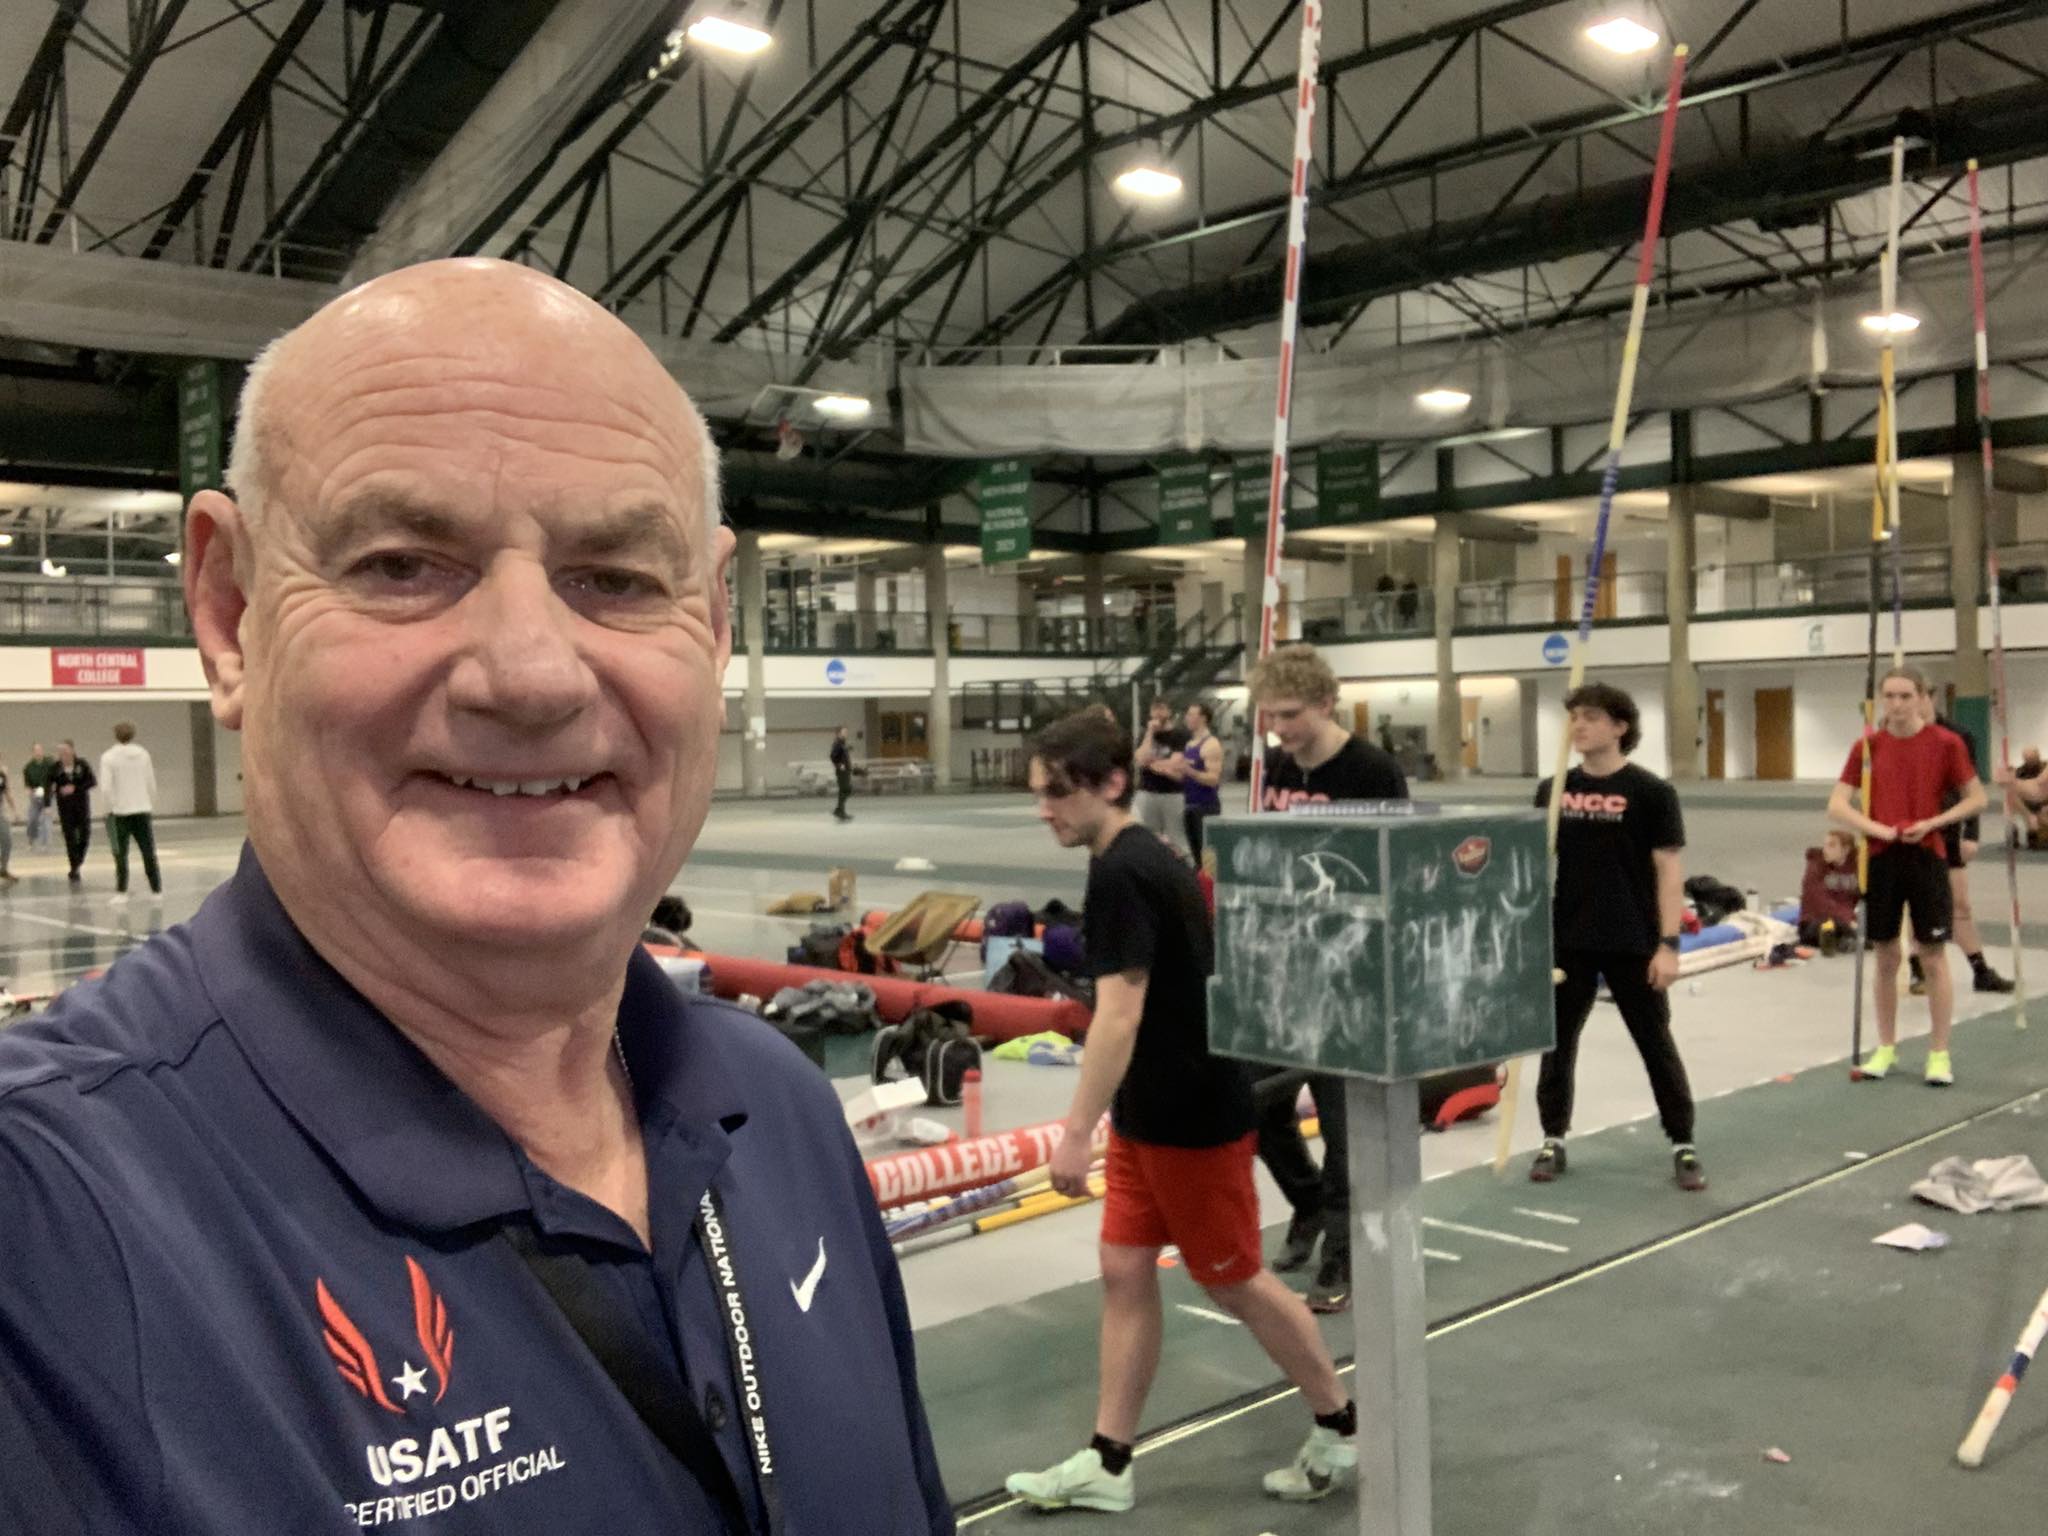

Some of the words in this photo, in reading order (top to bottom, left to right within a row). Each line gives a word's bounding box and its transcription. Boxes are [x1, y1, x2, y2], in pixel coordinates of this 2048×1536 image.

[58, 653, 94, 668] NORTH
[96, 652, 138, 668] CENTRAL
[77, 669, 120, 684] COLLEGE
[1561, 791, 1627, 813] NCC
[873, 1133, 1023, 1201] COLLEGE
[699, 1188, 737, 1287] NATIONA
[726, 1292, 761, 1410] OUTDOOR
[366, 1405, 512, 1487] USATF
[460, 1445, 567, 1503] OFFICIAL
[751, 1416, 773, 1474] NIKE
